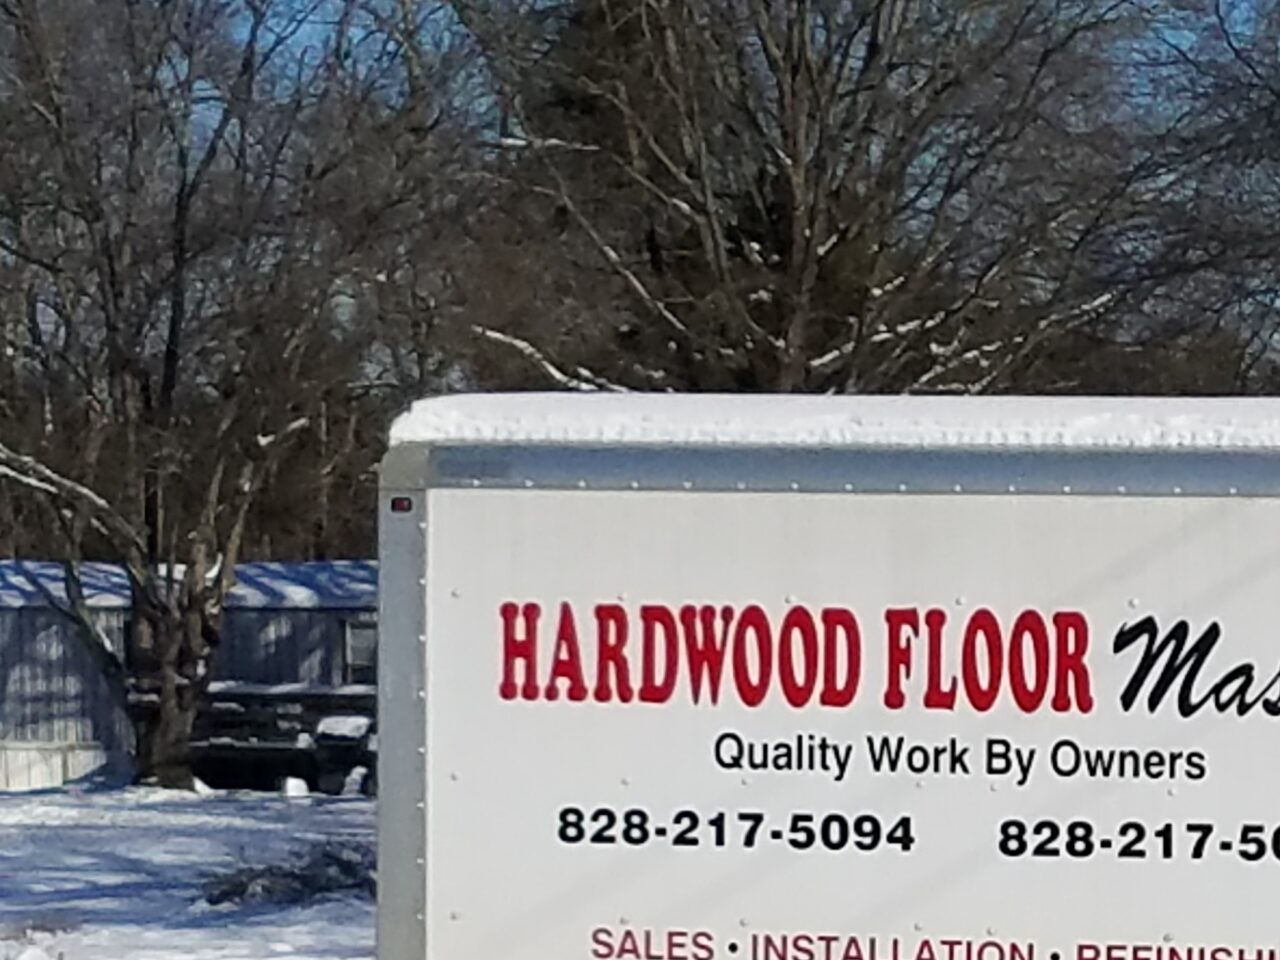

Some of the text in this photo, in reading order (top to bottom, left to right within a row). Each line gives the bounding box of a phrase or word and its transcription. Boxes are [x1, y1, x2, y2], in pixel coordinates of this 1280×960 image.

[499, 601, 861, 709] HARDWOOD
[883, 607, 1094, 714] FLOOR
[714, 732, 1206, 786] Quality Work By Owners
[558, 807, 915, 852] 828-217-5094
